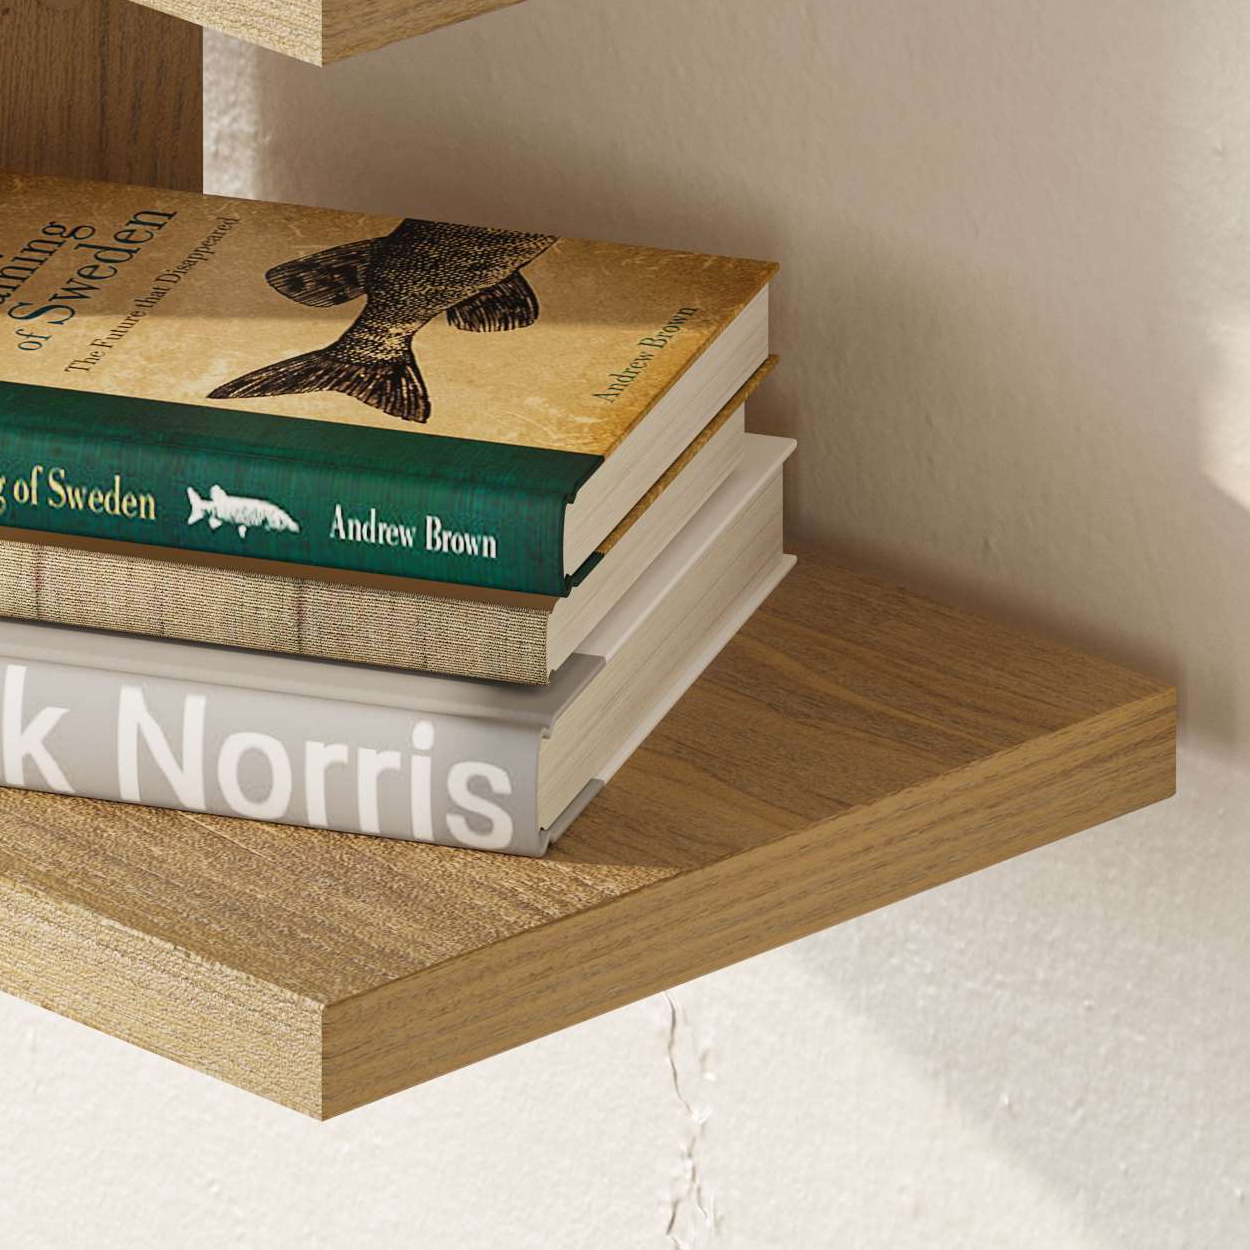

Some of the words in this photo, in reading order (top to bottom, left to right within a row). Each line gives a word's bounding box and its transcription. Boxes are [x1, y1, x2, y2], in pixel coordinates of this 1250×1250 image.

[8, 209, 177, 326] Sweden
[64, 350, 106, 372] The
[91, 310, 147, 348] Future
[134, 286, 170, 313] that
[154, 217, 240, 284] Disappeared
[15, 328, 52, 351] of
[591, 351, 654, 403] Andrew
[637, 307, 701, 349] Brown
[13, 464, 45, 506] of
[48, 467, 156, 521] Sweden
[329, 504, 416, 549] Andrew
[424, 515, 497, 559] Brown
[116, 682, 516, 851] Norris
